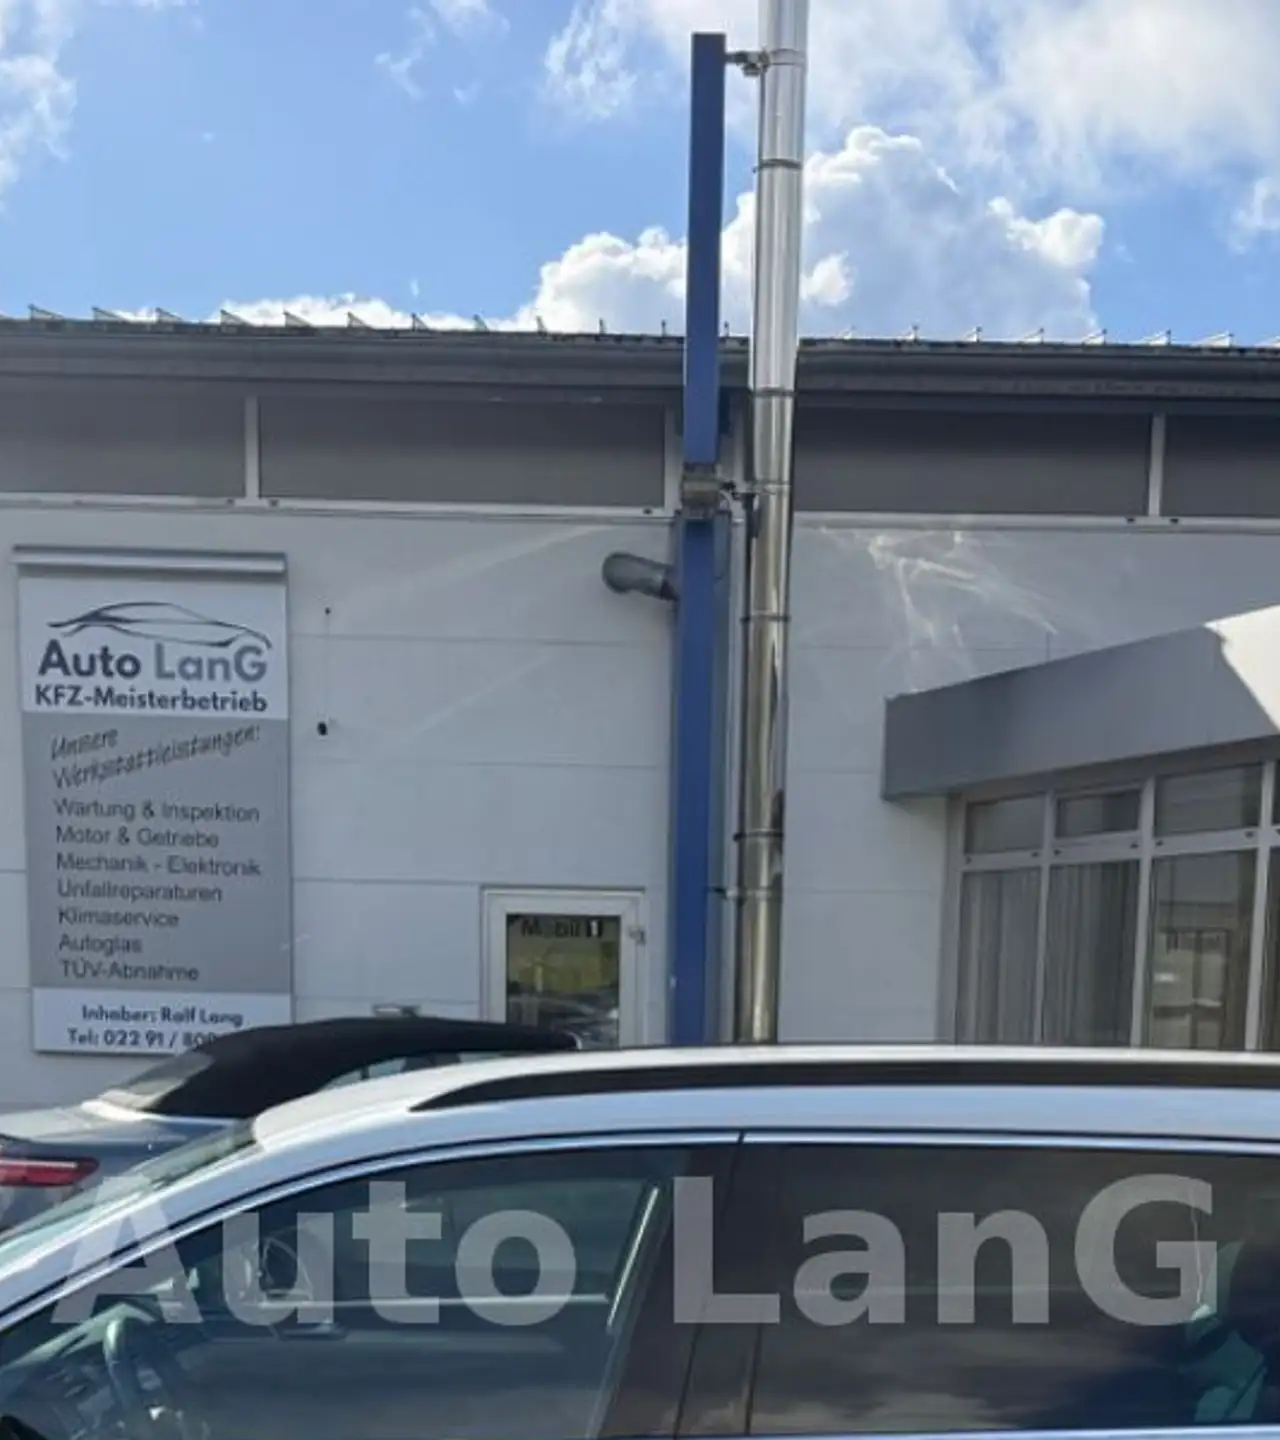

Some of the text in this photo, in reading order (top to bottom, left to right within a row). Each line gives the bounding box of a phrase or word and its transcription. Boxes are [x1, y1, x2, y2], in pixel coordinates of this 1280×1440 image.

[38, 639, 268, 683] Auto LanG
[35, 683, 268, 712] KFZ-Meisterbetrieb
[52, 729, 118, 760] Unsere
[53, 799, 261, 823] Wartung & Inspektion
[56, 825, 220, 848] Motor & Getriebe
[56, 852, 148, 873] Mechanik
[168, 855, 261, 877] Elektronik
[57, 879, 223, 902] Unfallreparaturen
[58, 907, 180, 928] Klimaservice
[59, 934, 143, 957] Autoglas
[61, 957, 200, 981] TÜV-Abnahme
[82, 1005, 154, 1023] Inhaber:
[67, 1028, 99, 1046] Tel:
[104, 1029, 140, 1046] 022
[145, 1030, 165, 1047] 91
